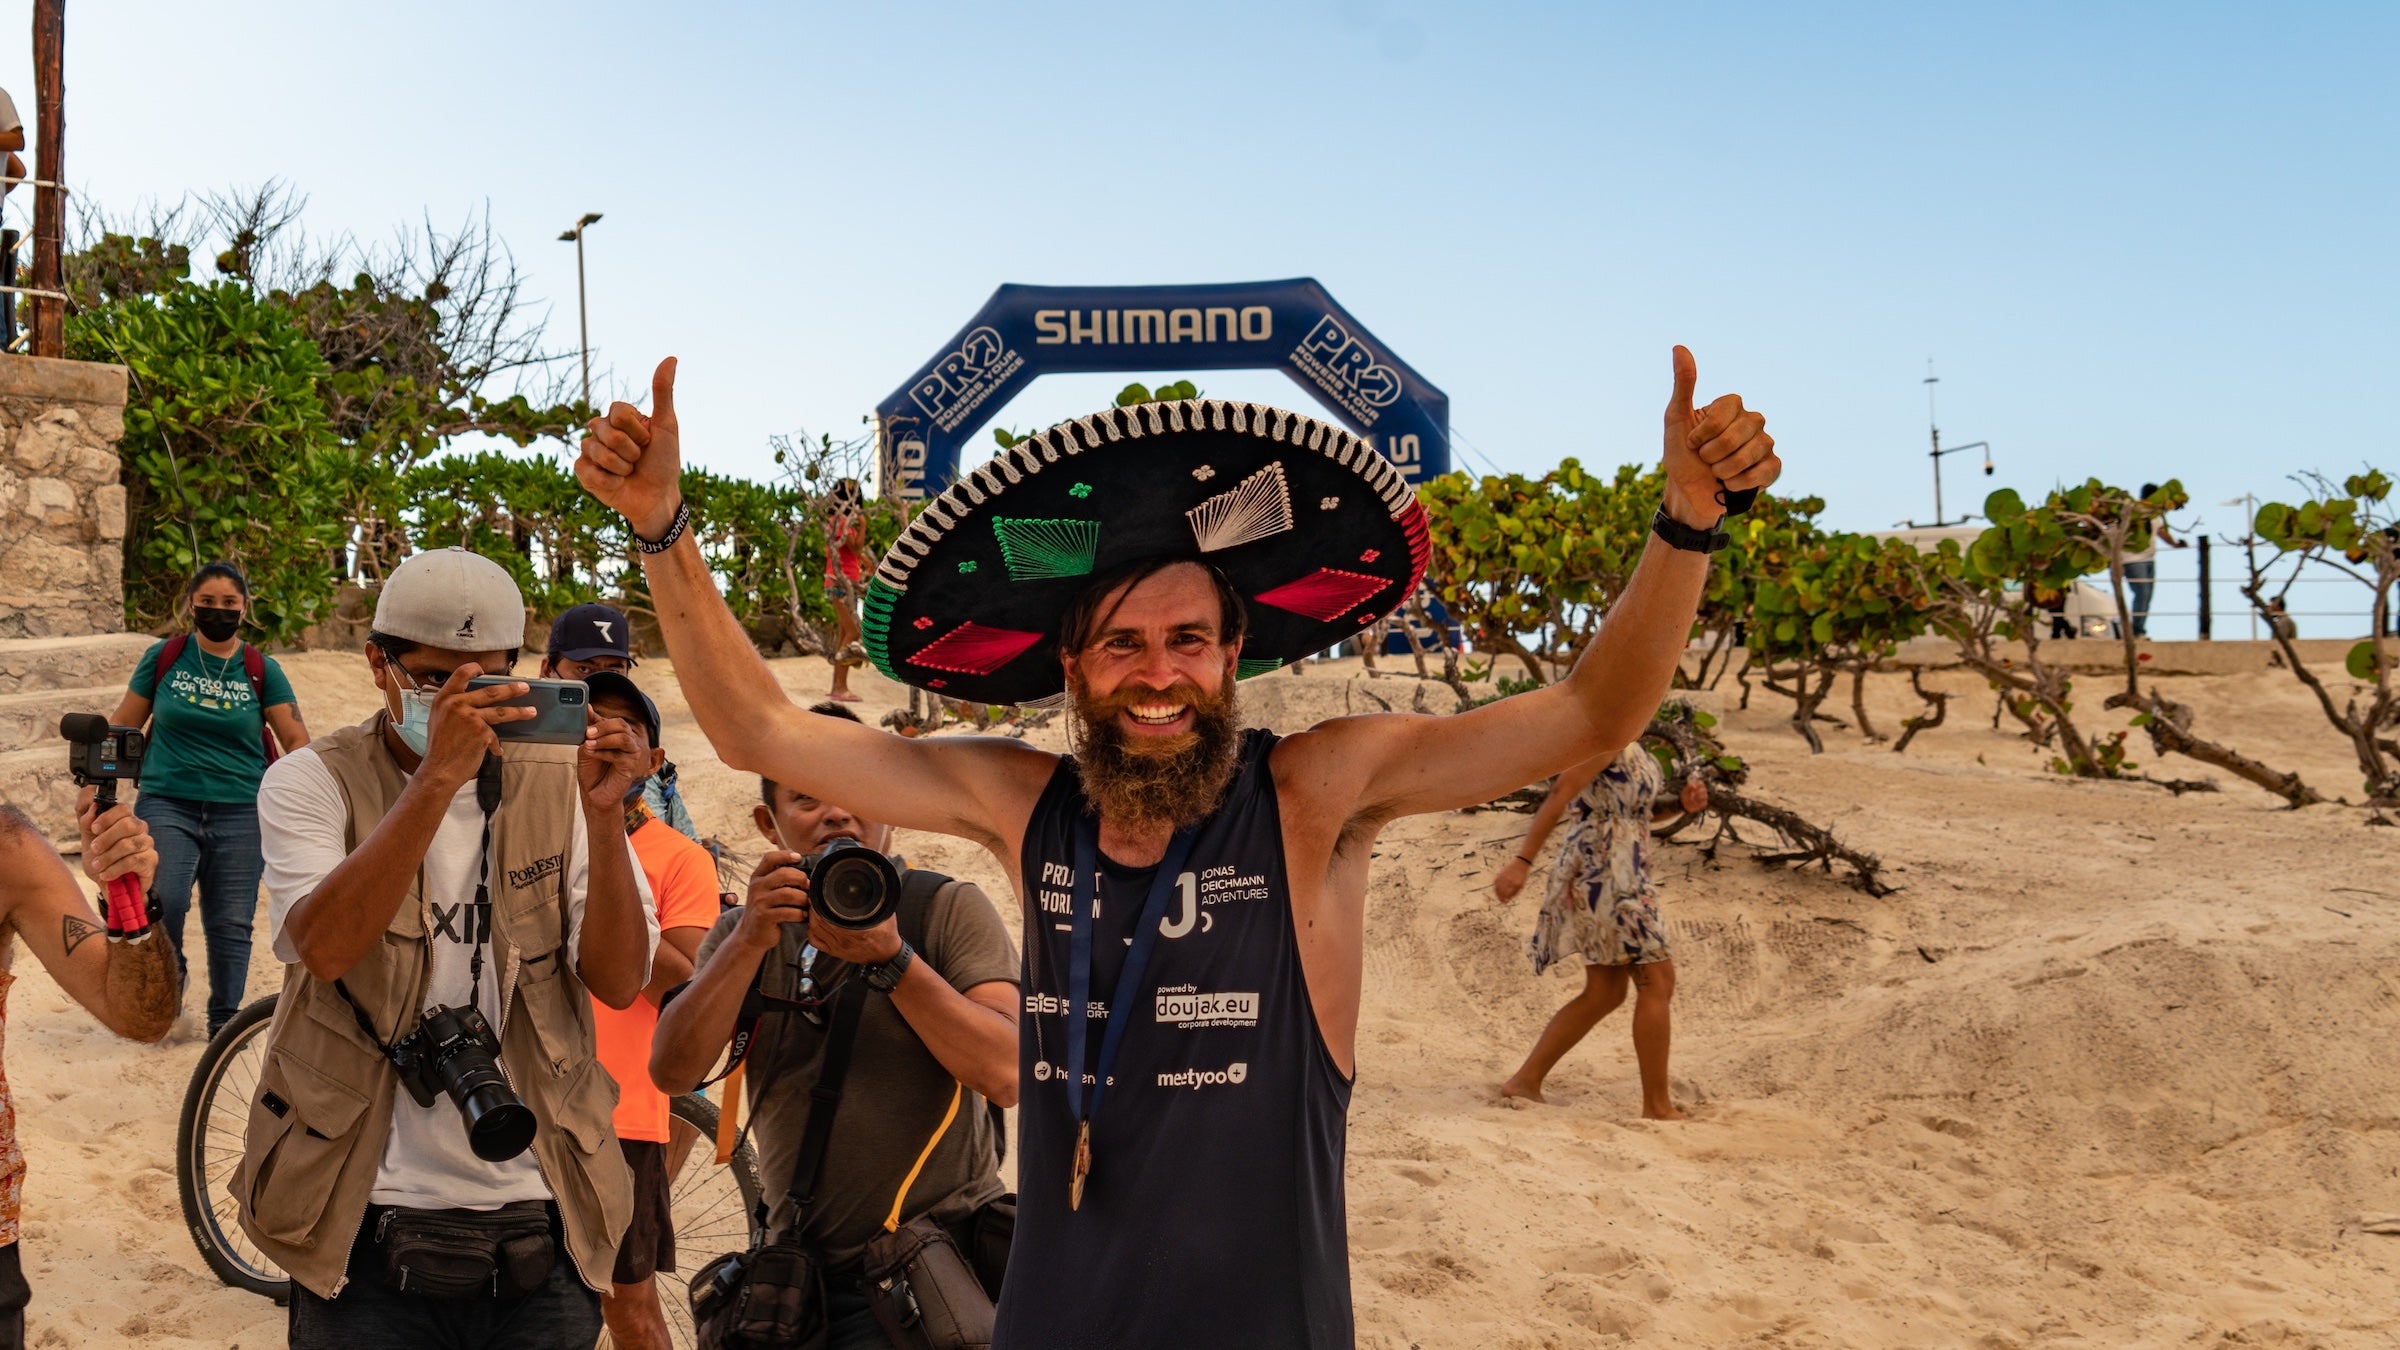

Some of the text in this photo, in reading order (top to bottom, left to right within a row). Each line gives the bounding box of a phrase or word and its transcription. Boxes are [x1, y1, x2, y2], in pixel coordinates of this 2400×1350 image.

[1035, 306, 1273, 344] SHIMANO
[935, 349, 1017, 425] POWERS YOUR
[943, 356, 1025, 433] PERFORMANCE
[1289, 353, 1374, 428] PERFORMANCE
[1295, 345, 1380, 422] POWERS YOUR
[664, 504, 690, 547] JONAS
[171, 680, 196, 692] POR
[176, 670, 191, 680] YO
[226, 680, 249, 691] VINE
[1200, 865, 1235, 880] JONAS
[1201, 875, 1265, 893] DEICHMANN
[1040, 890, 1101, 919] HORIN
[1201, 887, 1269, 906] ADVENTURES
[1157, 983, 1198, 995] powered by
[1157, 993, 1250, 1020] doujak.eu
[1178, 1018, 1257, 1030] corporate development
[734, 1031, 749, 1056] 60D
[1157, 1068, 1227, 1091] meetyoo
